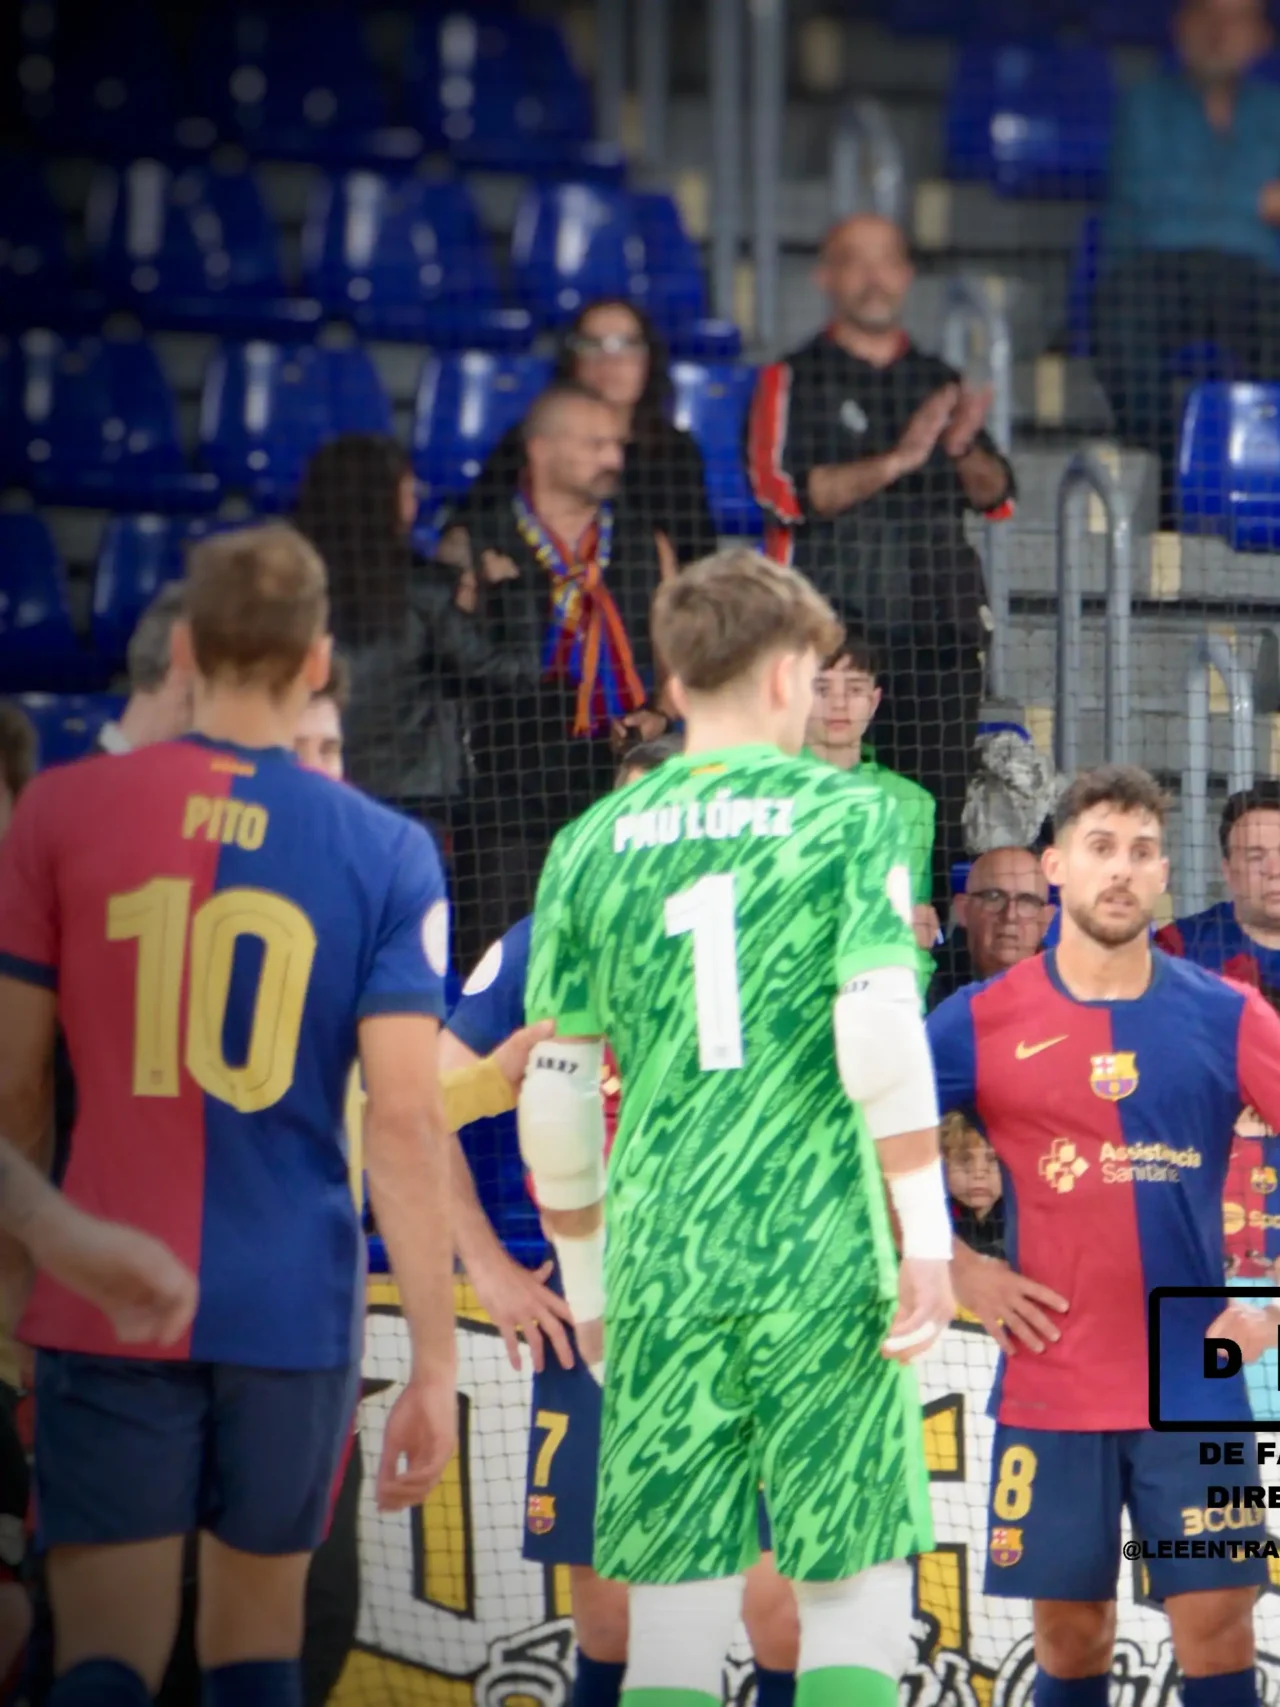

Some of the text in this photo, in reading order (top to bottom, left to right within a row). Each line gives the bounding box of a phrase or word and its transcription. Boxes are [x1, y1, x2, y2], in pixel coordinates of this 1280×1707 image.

[182, 796, 269, 850] PITO
[614, 786, 794, 853] PAU LÓPEZ
[106, 876, 318, 1113] 10
[664, 872, 743, 1072] 1
[532, 1411, 569, 1487] 7
[992, 1444, 1038, 1521] 8
